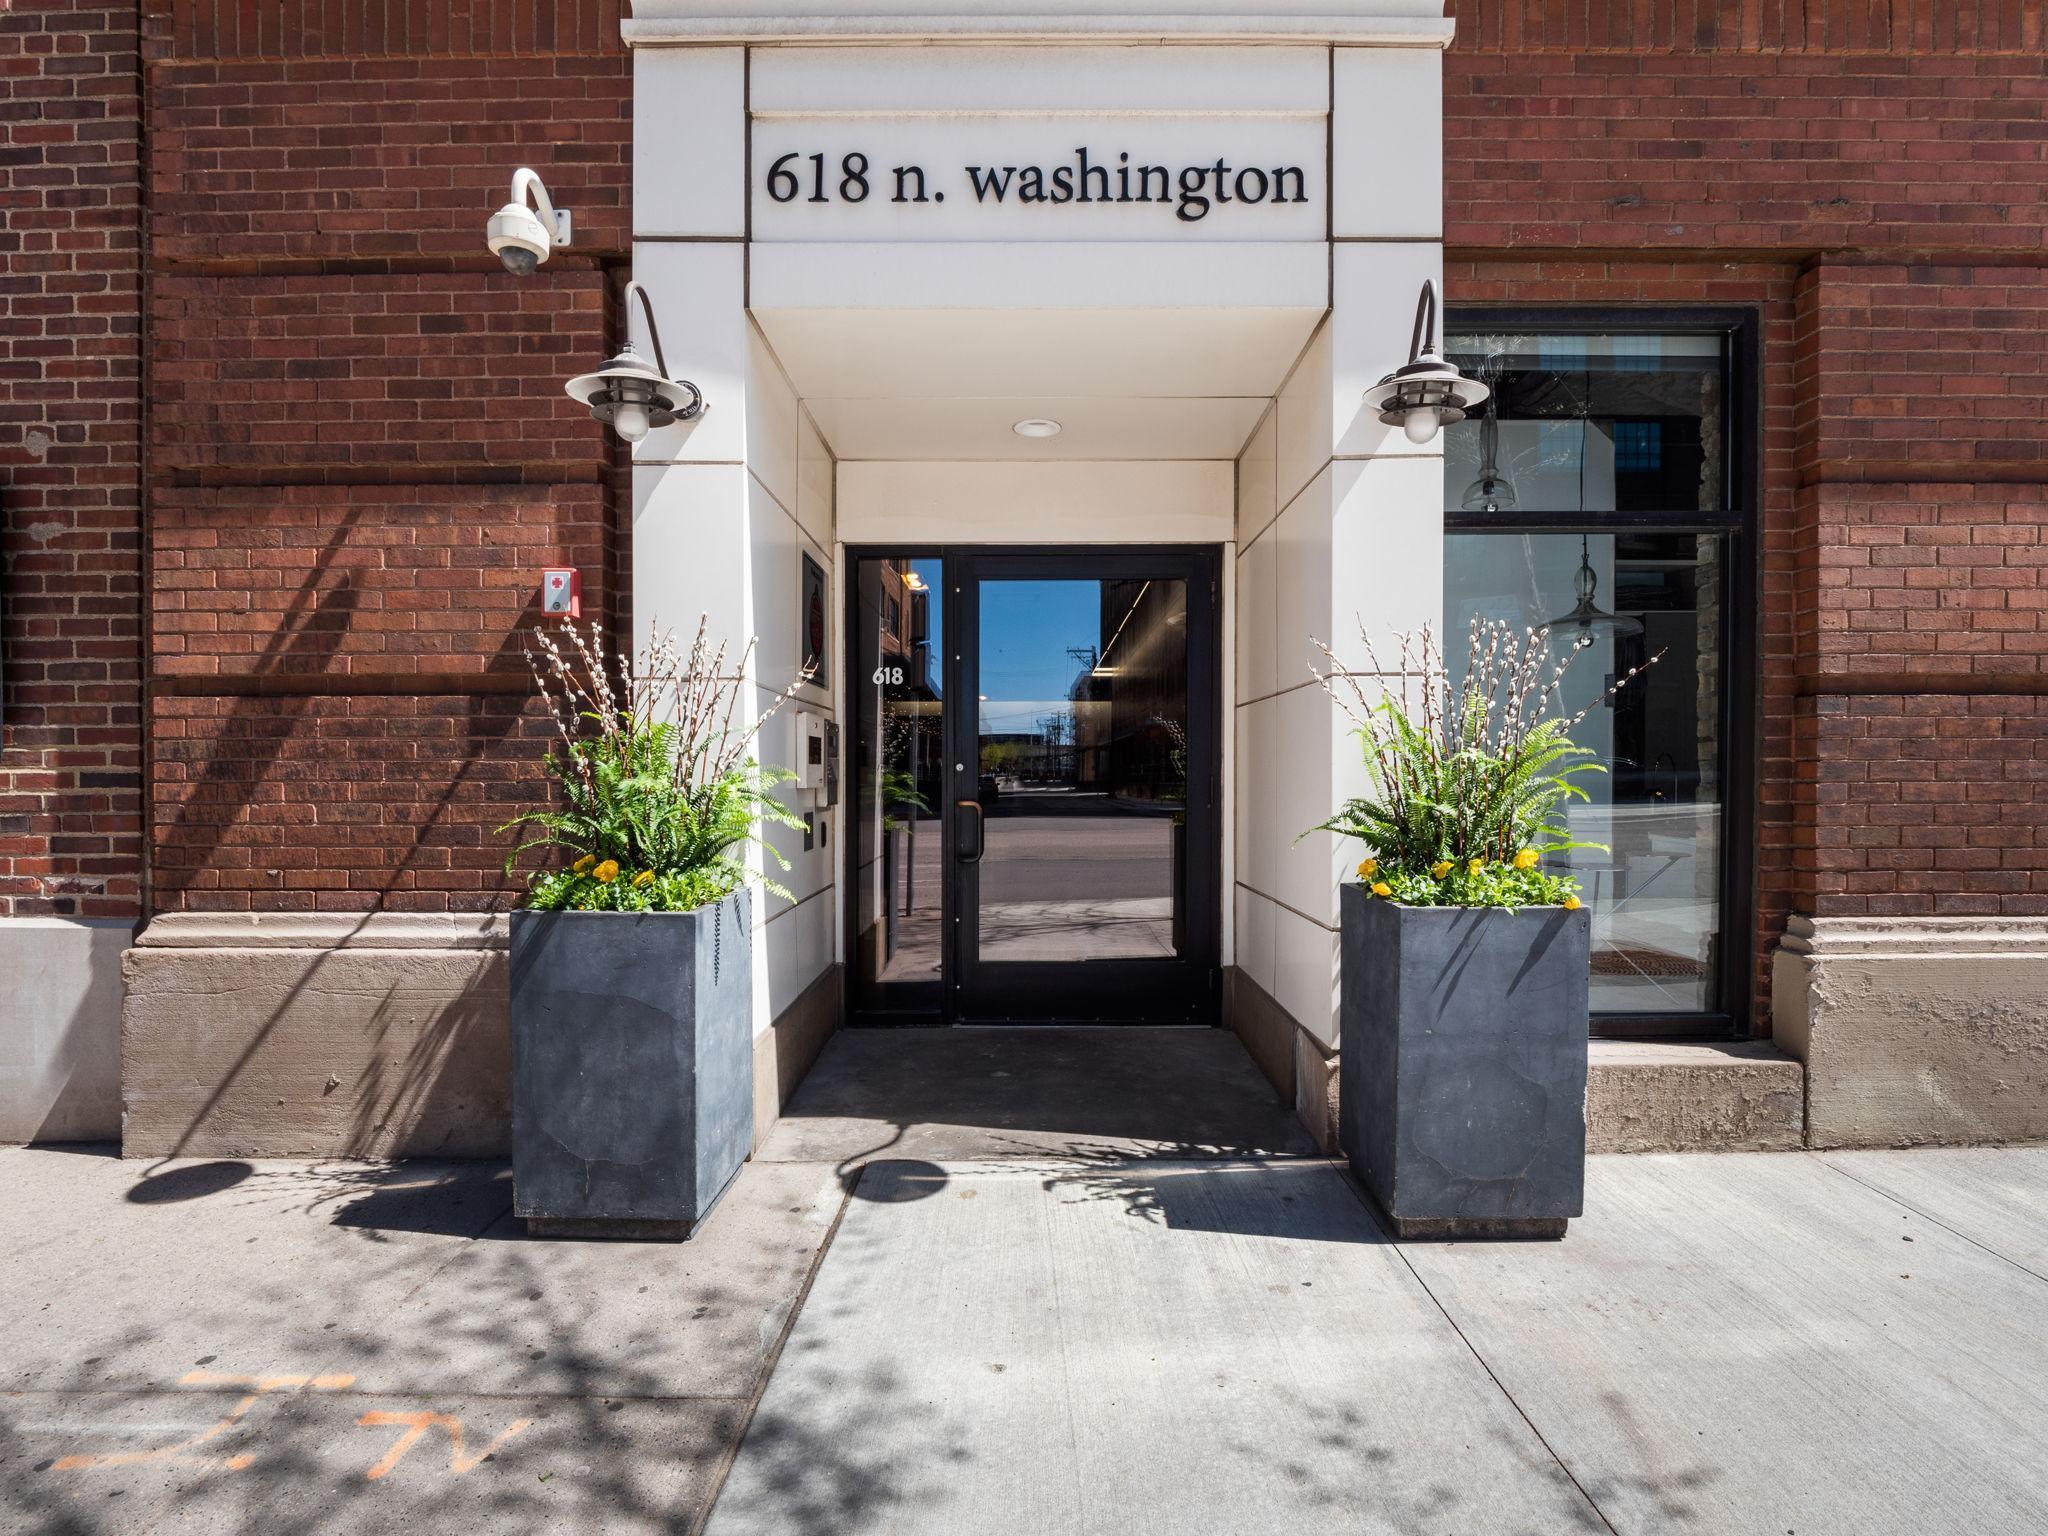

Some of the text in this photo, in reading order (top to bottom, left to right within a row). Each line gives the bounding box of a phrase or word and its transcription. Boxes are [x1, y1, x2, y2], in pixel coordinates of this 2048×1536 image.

[766, 147, 1309, 222] 618 n. washington
[872, 667, 904, 685] 618
